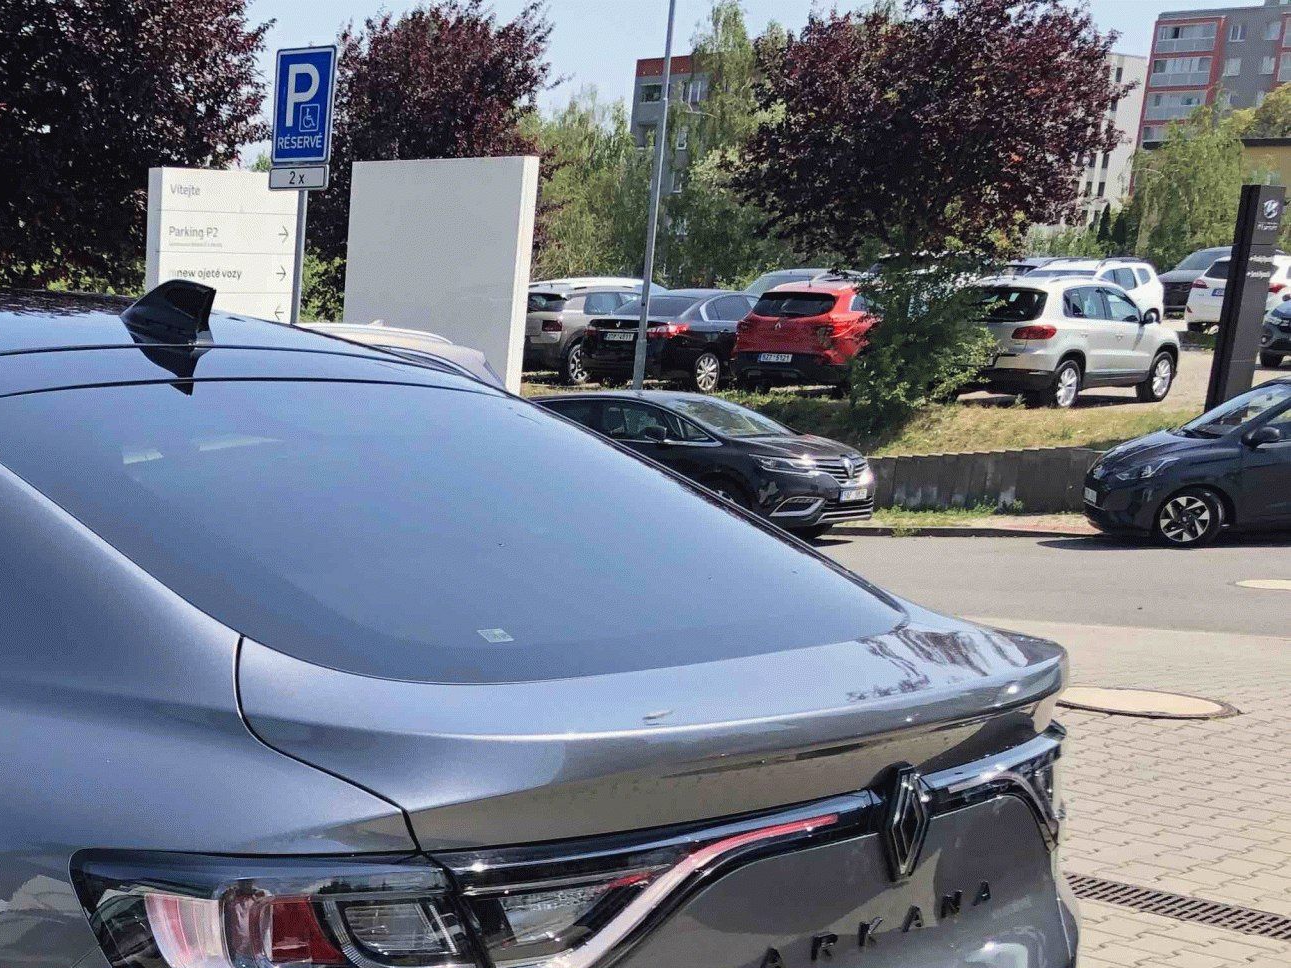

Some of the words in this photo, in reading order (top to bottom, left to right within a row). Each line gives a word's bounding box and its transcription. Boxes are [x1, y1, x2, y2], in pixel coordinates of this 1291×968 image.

[286, 63, 320, 127] P
[277, 132, 323, 149] RÉSERVÉ
[289, 170, 297, 185] 2
[298, 173, 306, 184] x
[169, 226, 204, 239] Parking
[206, 227, 219, 238] P2
[221, 269, 242, 280] vozy
